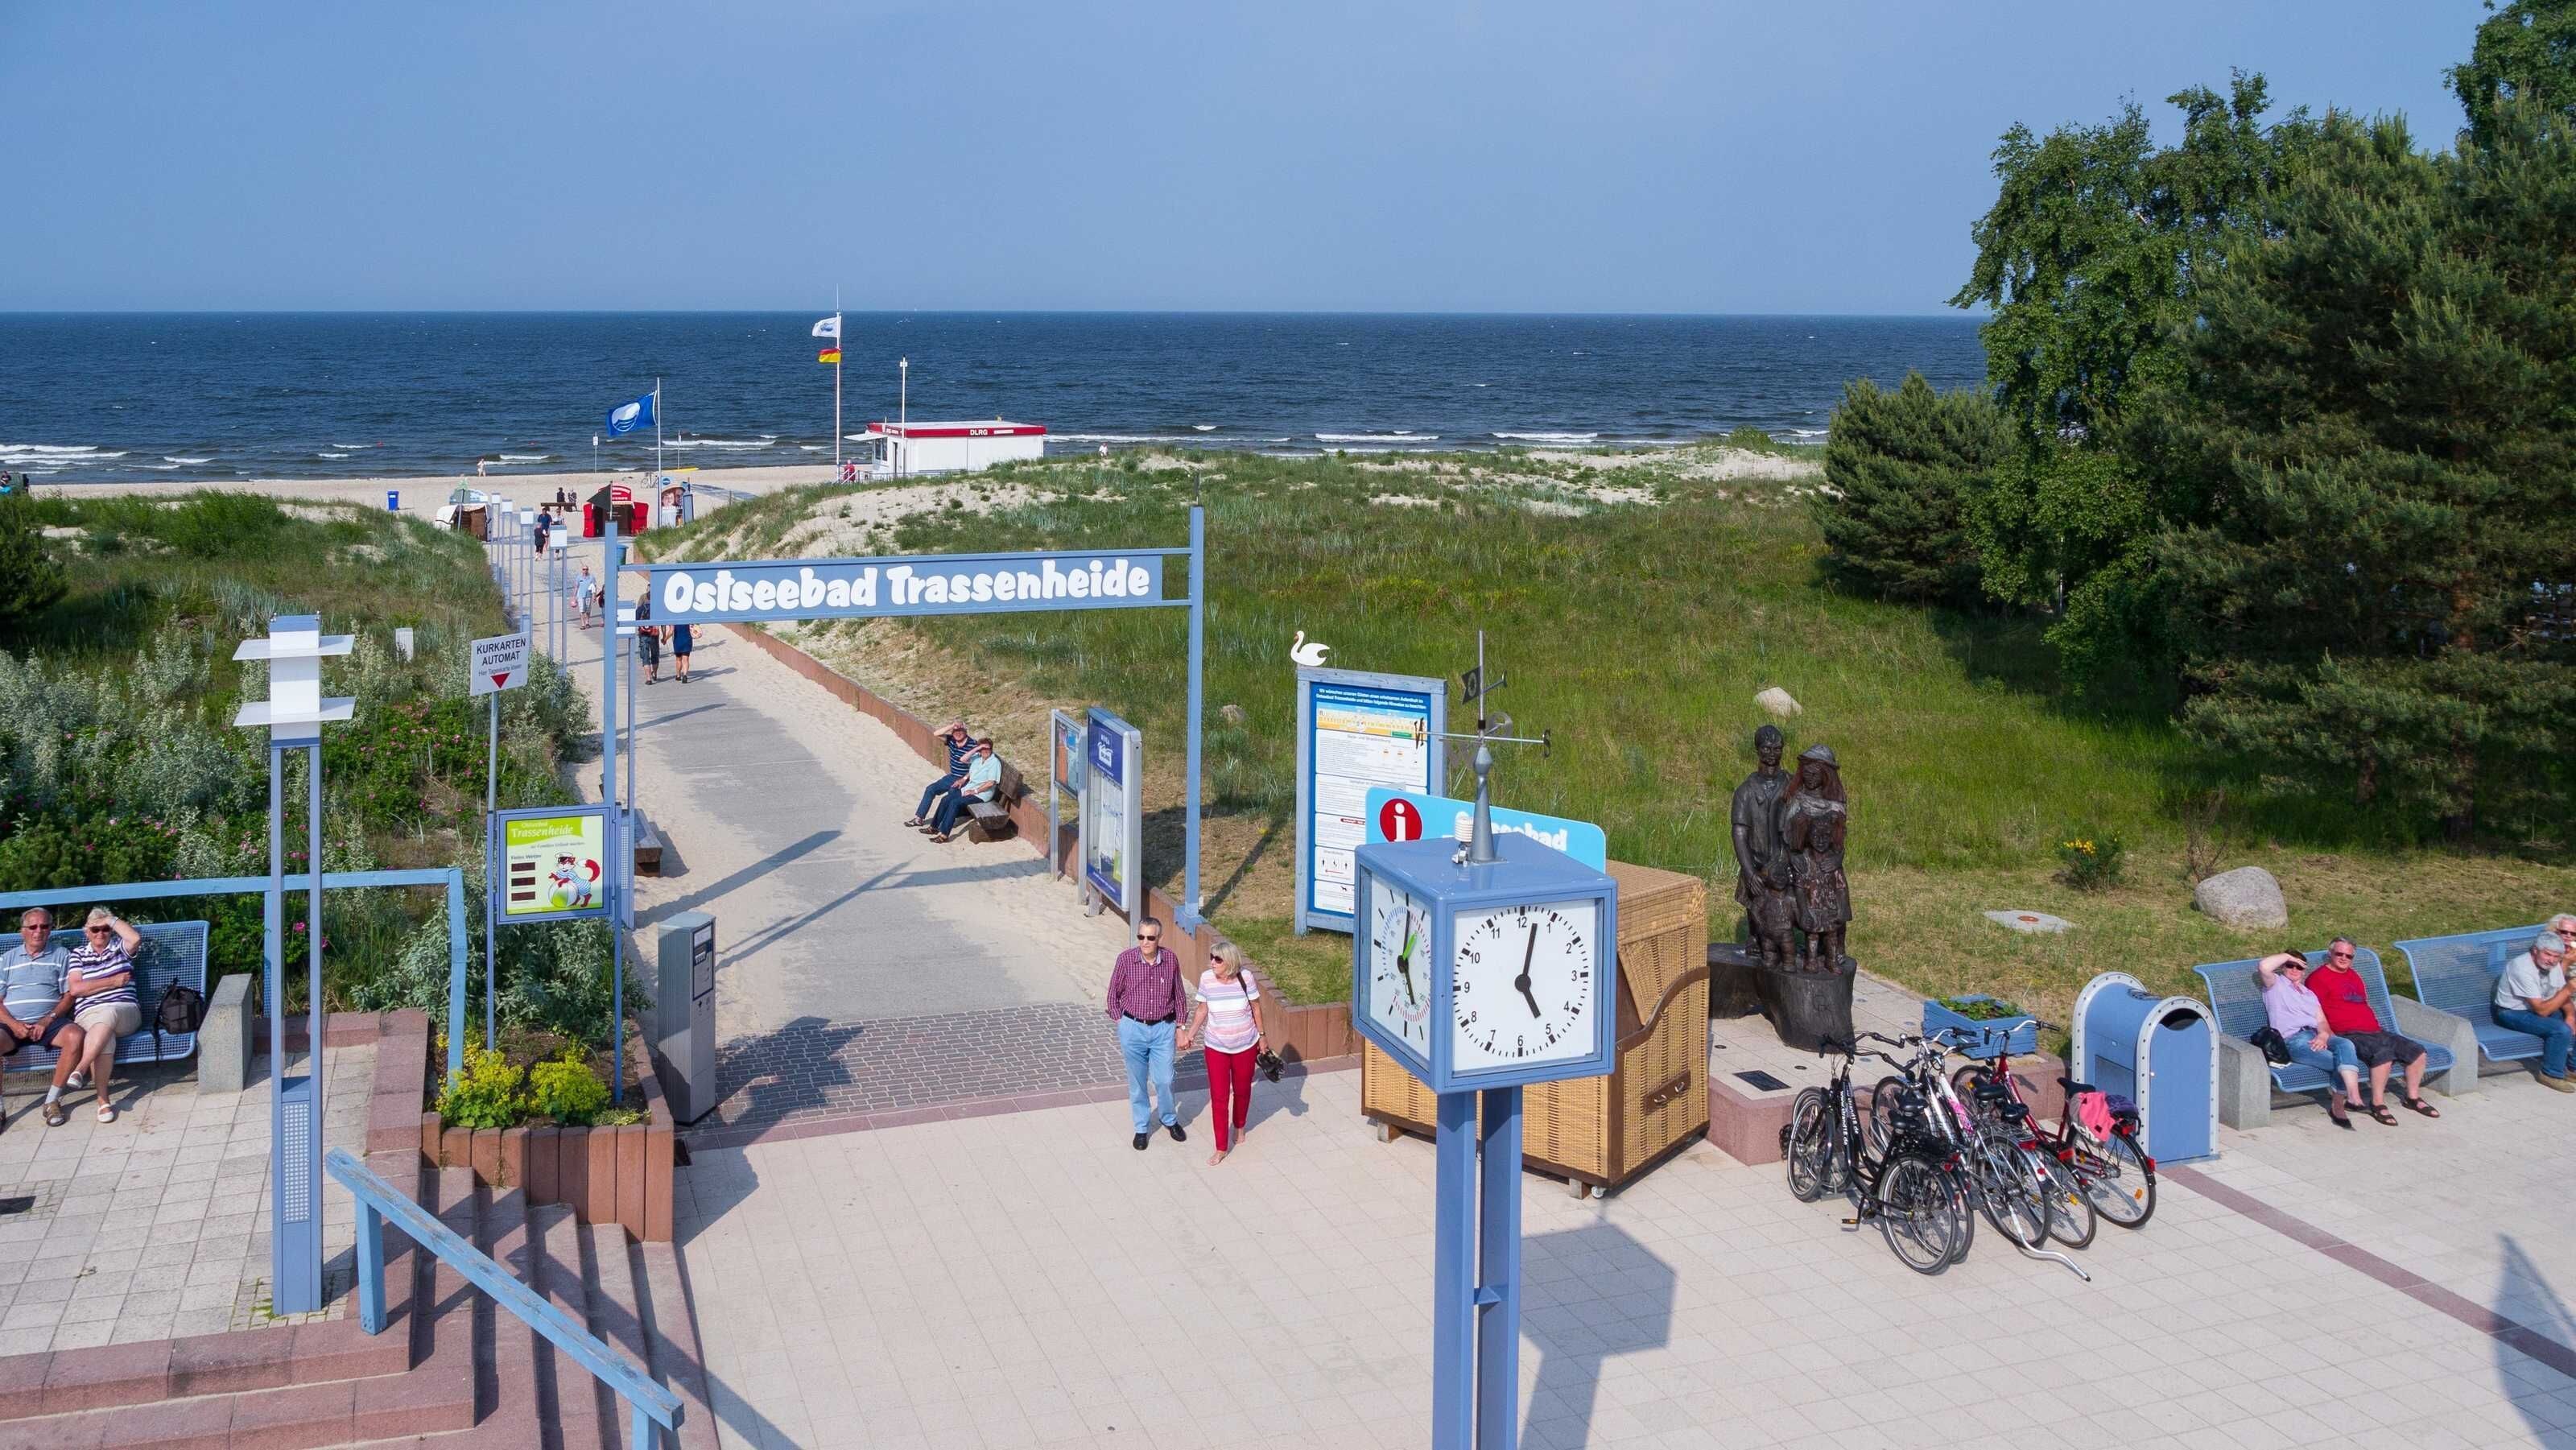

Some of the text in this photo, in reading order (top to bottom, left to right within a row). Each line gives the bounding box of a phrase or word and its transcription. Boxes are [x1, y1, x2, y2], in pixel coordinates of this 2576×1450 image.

[663, 559, 1150, 614] Ostseebad Trassenheide
[477, 637, 526, 655] KURKARTEN
[482, 651, 520, 666] AUTOMAT
[511, 824, 574, 838] Trassenheide
[1517, 917, 1527, 928] 12
[1491, 928, 1501, 939] 11
[1546, 923, 1551, 934] 1
[1566, 943, 1572, 954] 2
[1469, 952, 1480, 964] 10
[1571, 970, 1577, 981] 3
[1463, 981, 1470, 993] 9
[1563, 1001, 1570, 1012] 4
[1471, 1011, 1477, 1022] 8
[1545, 1023, 1551, 1035] 5
[1490, 1030, 1496, 1041] 7
[1517, 1035, 1524, 1047] 6
